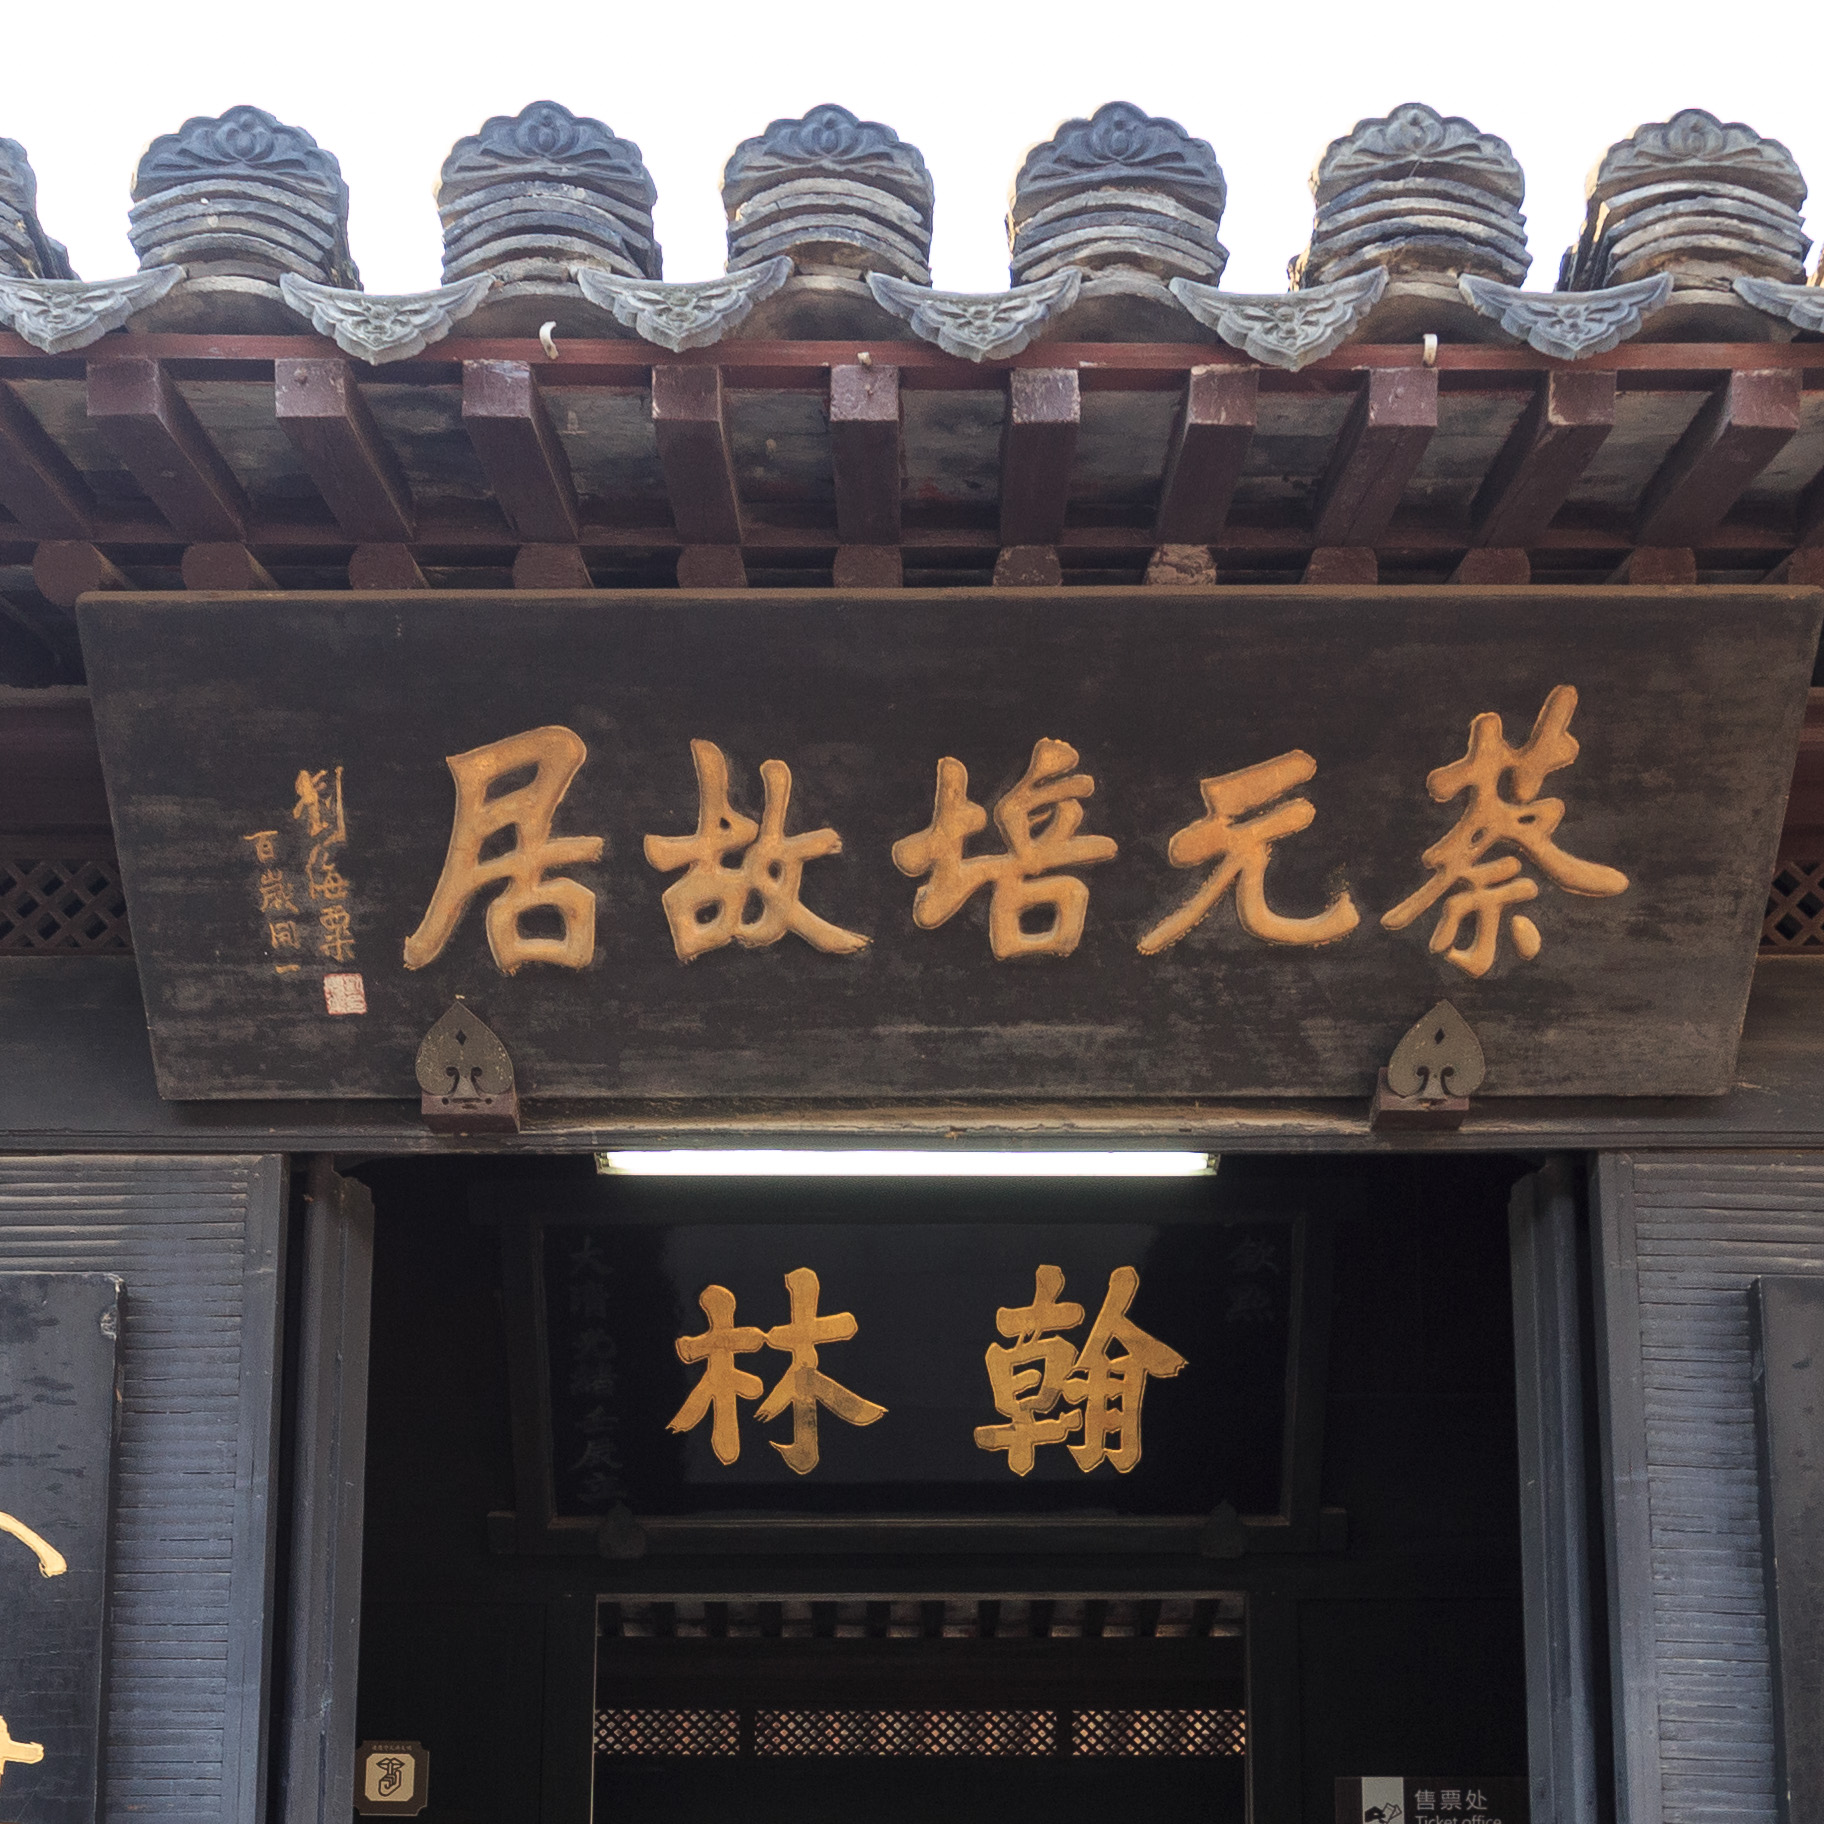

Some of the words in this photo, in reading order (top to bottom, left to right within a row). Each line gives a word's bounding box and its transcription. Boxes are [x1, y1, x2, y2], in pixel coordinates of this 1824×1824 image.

[404, 685, 1630, 978] 蔡元培故居
[666, 1264, 1190, 1477] 翰林
[1414, 1789, 1488, 1811] 售票处
